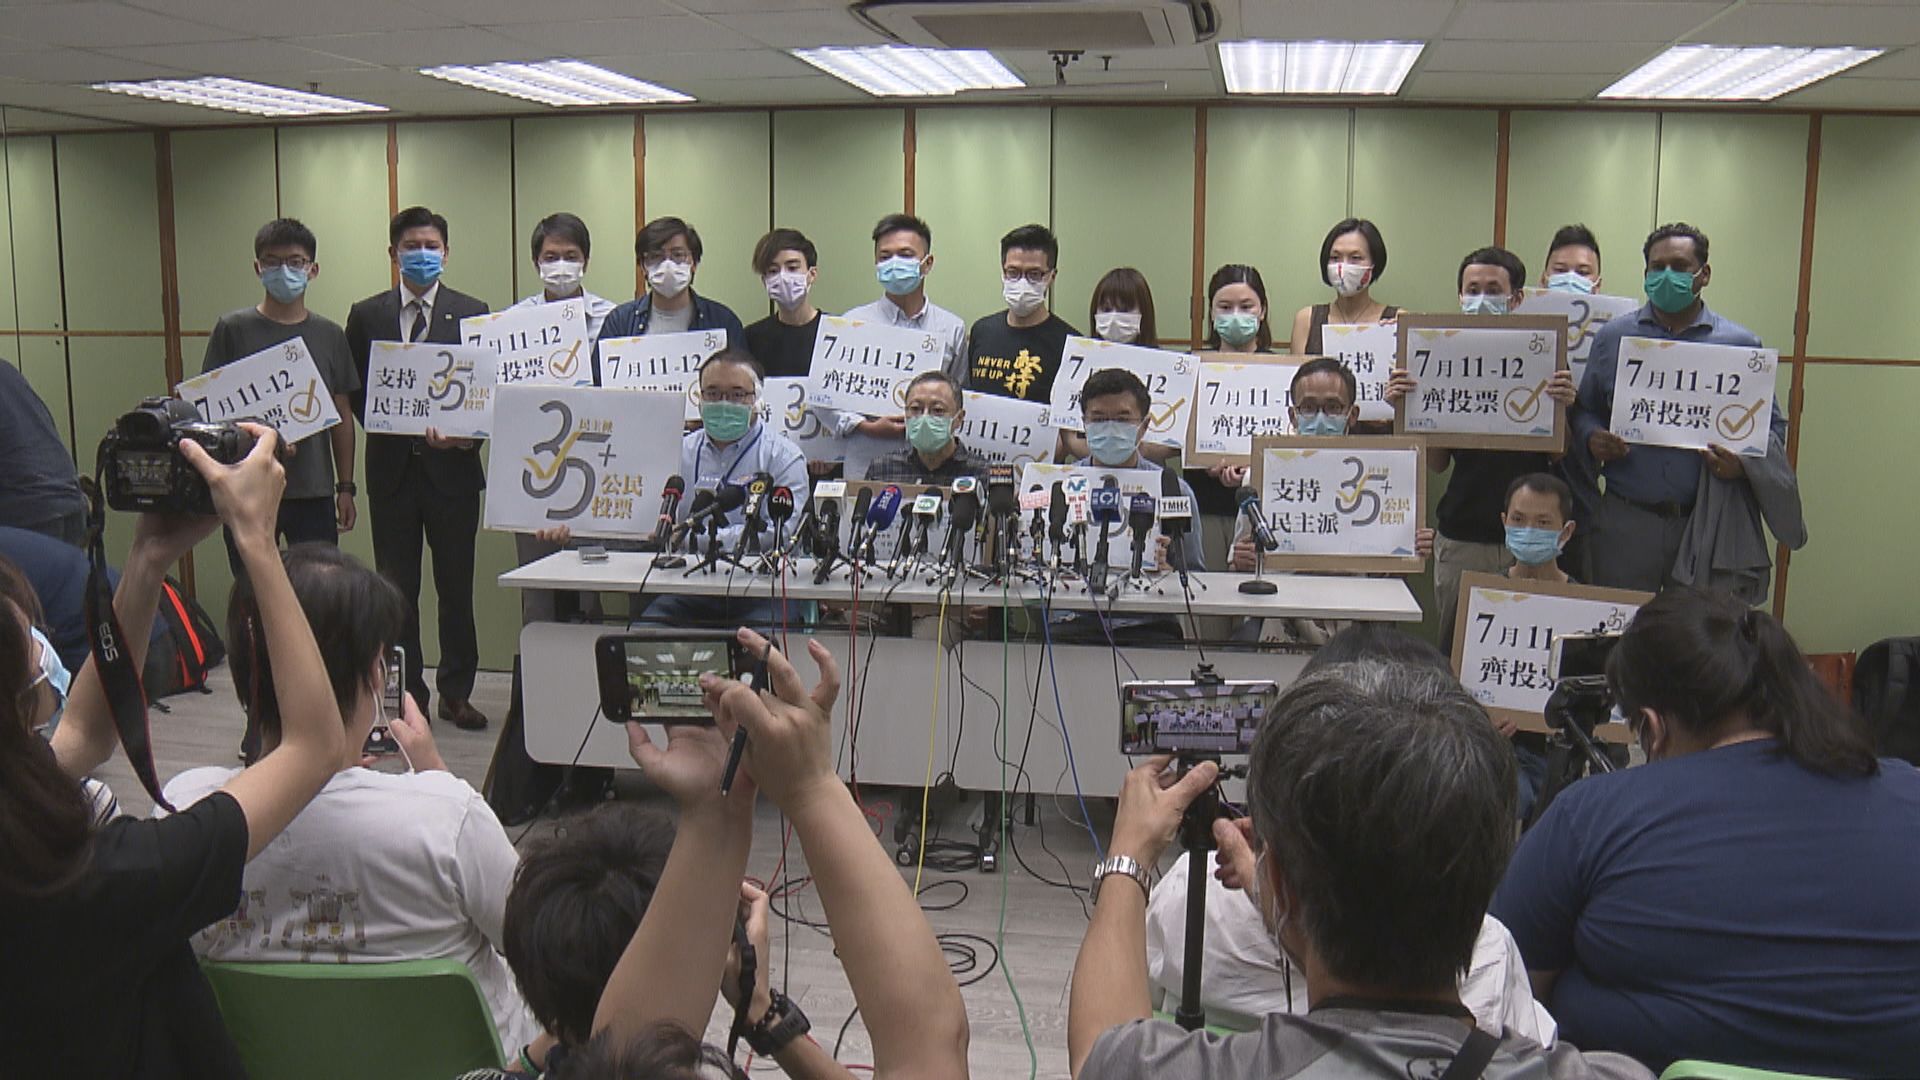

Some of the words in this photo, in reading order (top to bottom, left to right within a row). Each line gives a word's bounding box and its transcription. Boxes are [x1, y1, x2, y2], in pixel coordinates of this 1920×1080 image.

[823, 334, 915, 372] 7月11-12
[977, 355, 1011, 369] NEVER
[1414, 350, 1524, 379] 7月11-12
[376, 366, 417, 389] 支持
[496, 357, 544, 383] 投票
[607, 354, 701, 379] 7月11-12
[988, 369, 1004, 380] UP
[1626, 358, 1741, 396] 7月11-12
[372, 396, 430, 418] 民主派
[1206, 382, 1290, 407] 7月11-1
[1422, 388, 1499, 414] 齊投票
[1629, 398, 1713, 430] 齊投票
[960, 420, 1031, 446] 月11-12
[601, 472, 643, 497] 公民
[1271, 477, 1321, 503] 支持
[1271, 511, 1339, 535] 民主派
[99, 622, 119, 661] EOS
[1476, 613, 1552, 651] 7月11
